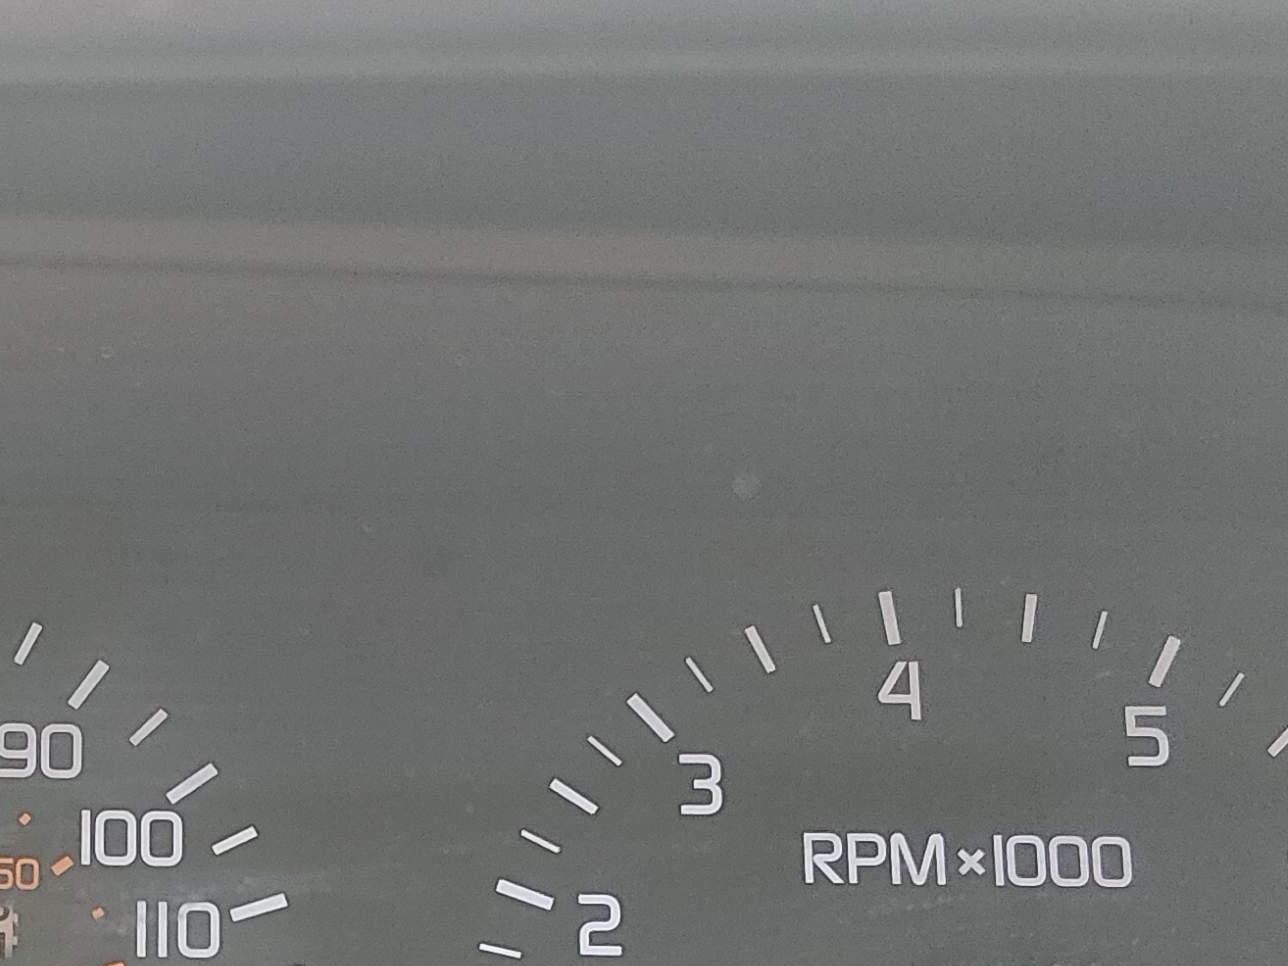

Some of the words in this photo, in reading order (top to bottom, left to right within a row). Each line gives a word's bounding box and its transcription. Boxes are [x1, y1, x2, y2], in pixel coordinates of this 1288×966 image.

[877, 661, 922, 721] 4
[1124, 705, 1170, 767] 5
[678, 753, 723, 815] 3
[81, 809, 183, 867] 100
[136, 900, 220, 958] 110
[578, 894, 623, 956] 2
